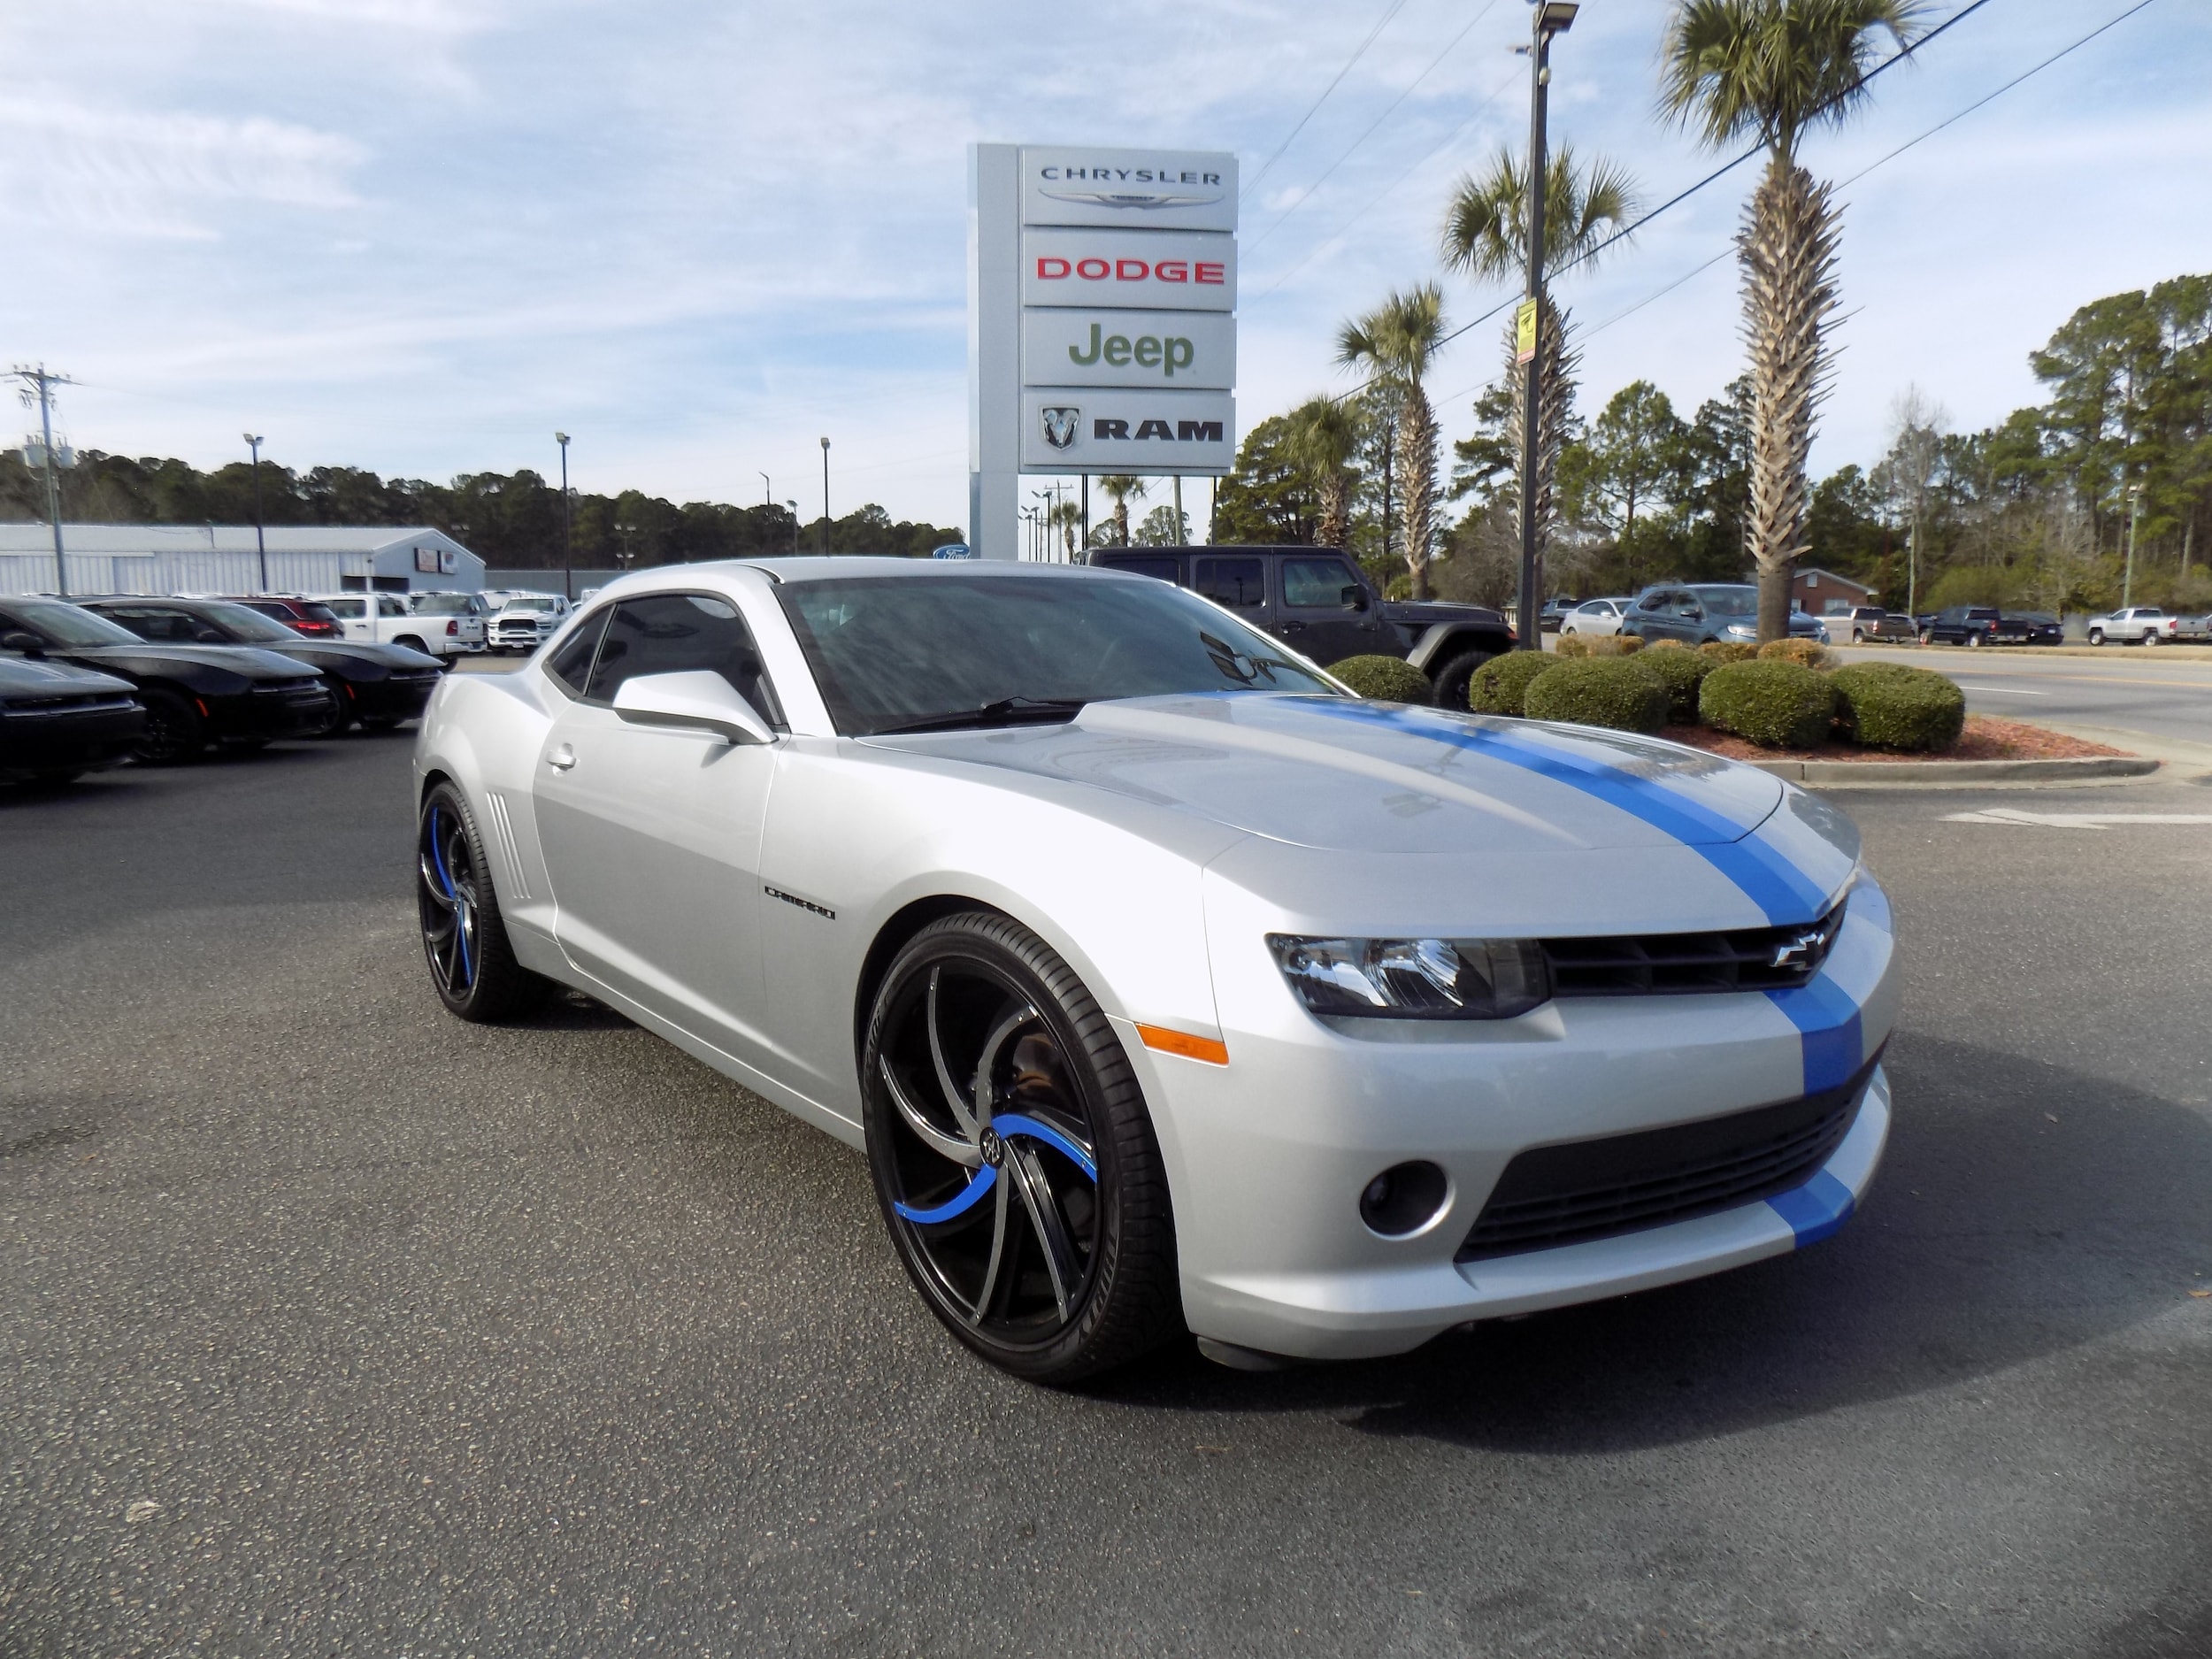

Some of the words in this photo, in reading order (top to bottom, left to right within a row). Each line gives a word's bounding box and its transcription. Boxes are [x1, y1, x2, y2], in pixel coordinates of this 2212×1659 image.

[1041, 167, 1220, 186] CHRYSLER
[1037, 258, 1225, 285] DODGE
[1069, 324, 1194, 377] Jeep
[1094, 419, 1223, 442] RAM
[764, 886, 836, 920] CAMARO
